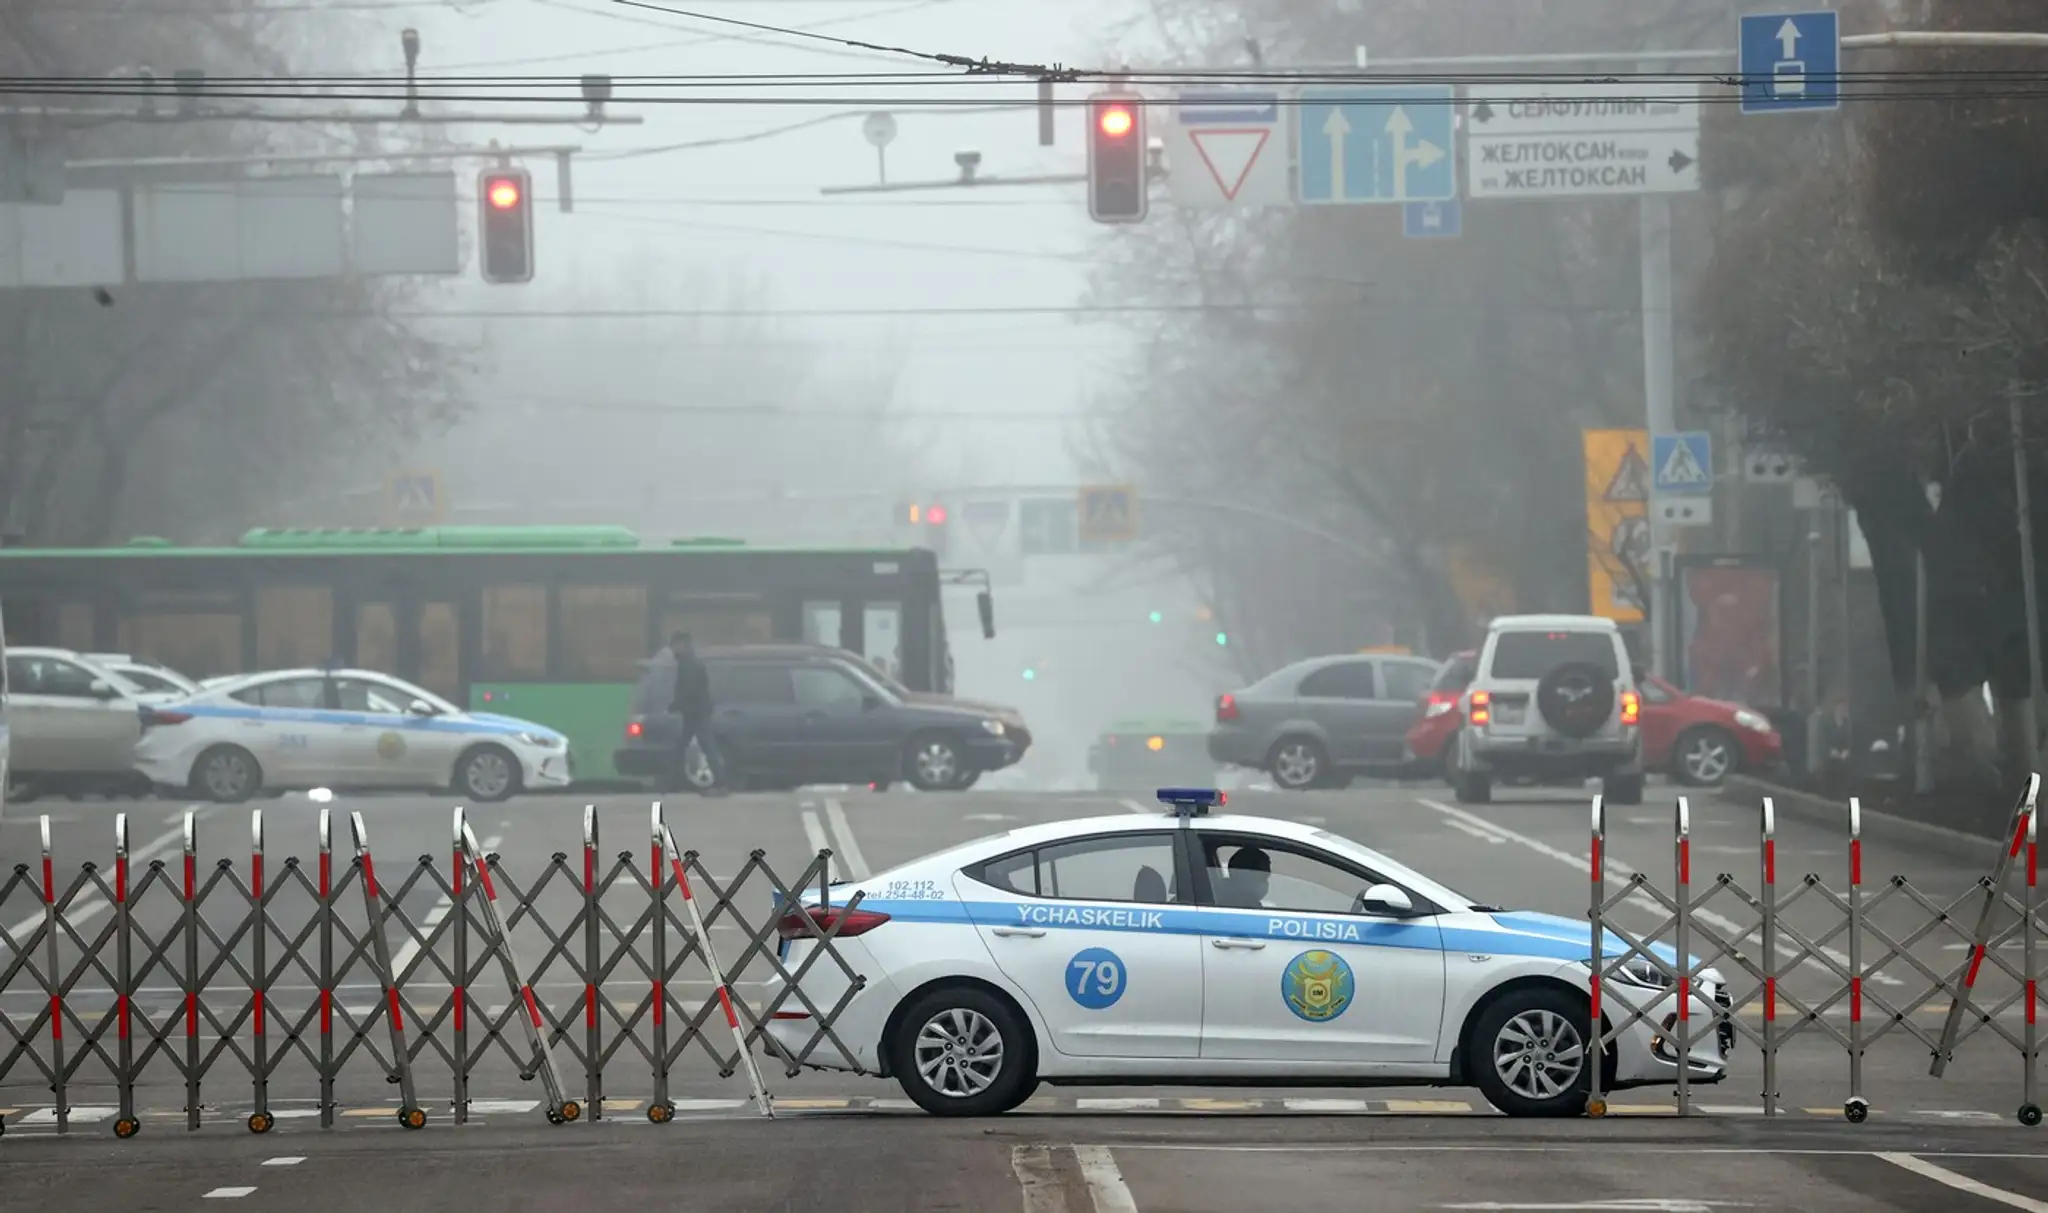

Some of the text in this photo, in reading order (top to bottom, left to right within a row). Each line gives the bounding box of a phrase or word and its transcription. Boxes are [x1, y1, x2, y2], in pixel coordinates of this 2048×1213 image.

[1504, 165, 1646, 189] ЖЕЛТОКСАН
[1268, 918, 1360, 941] POLISIA
[1073, 960, 1119, 996] 79
